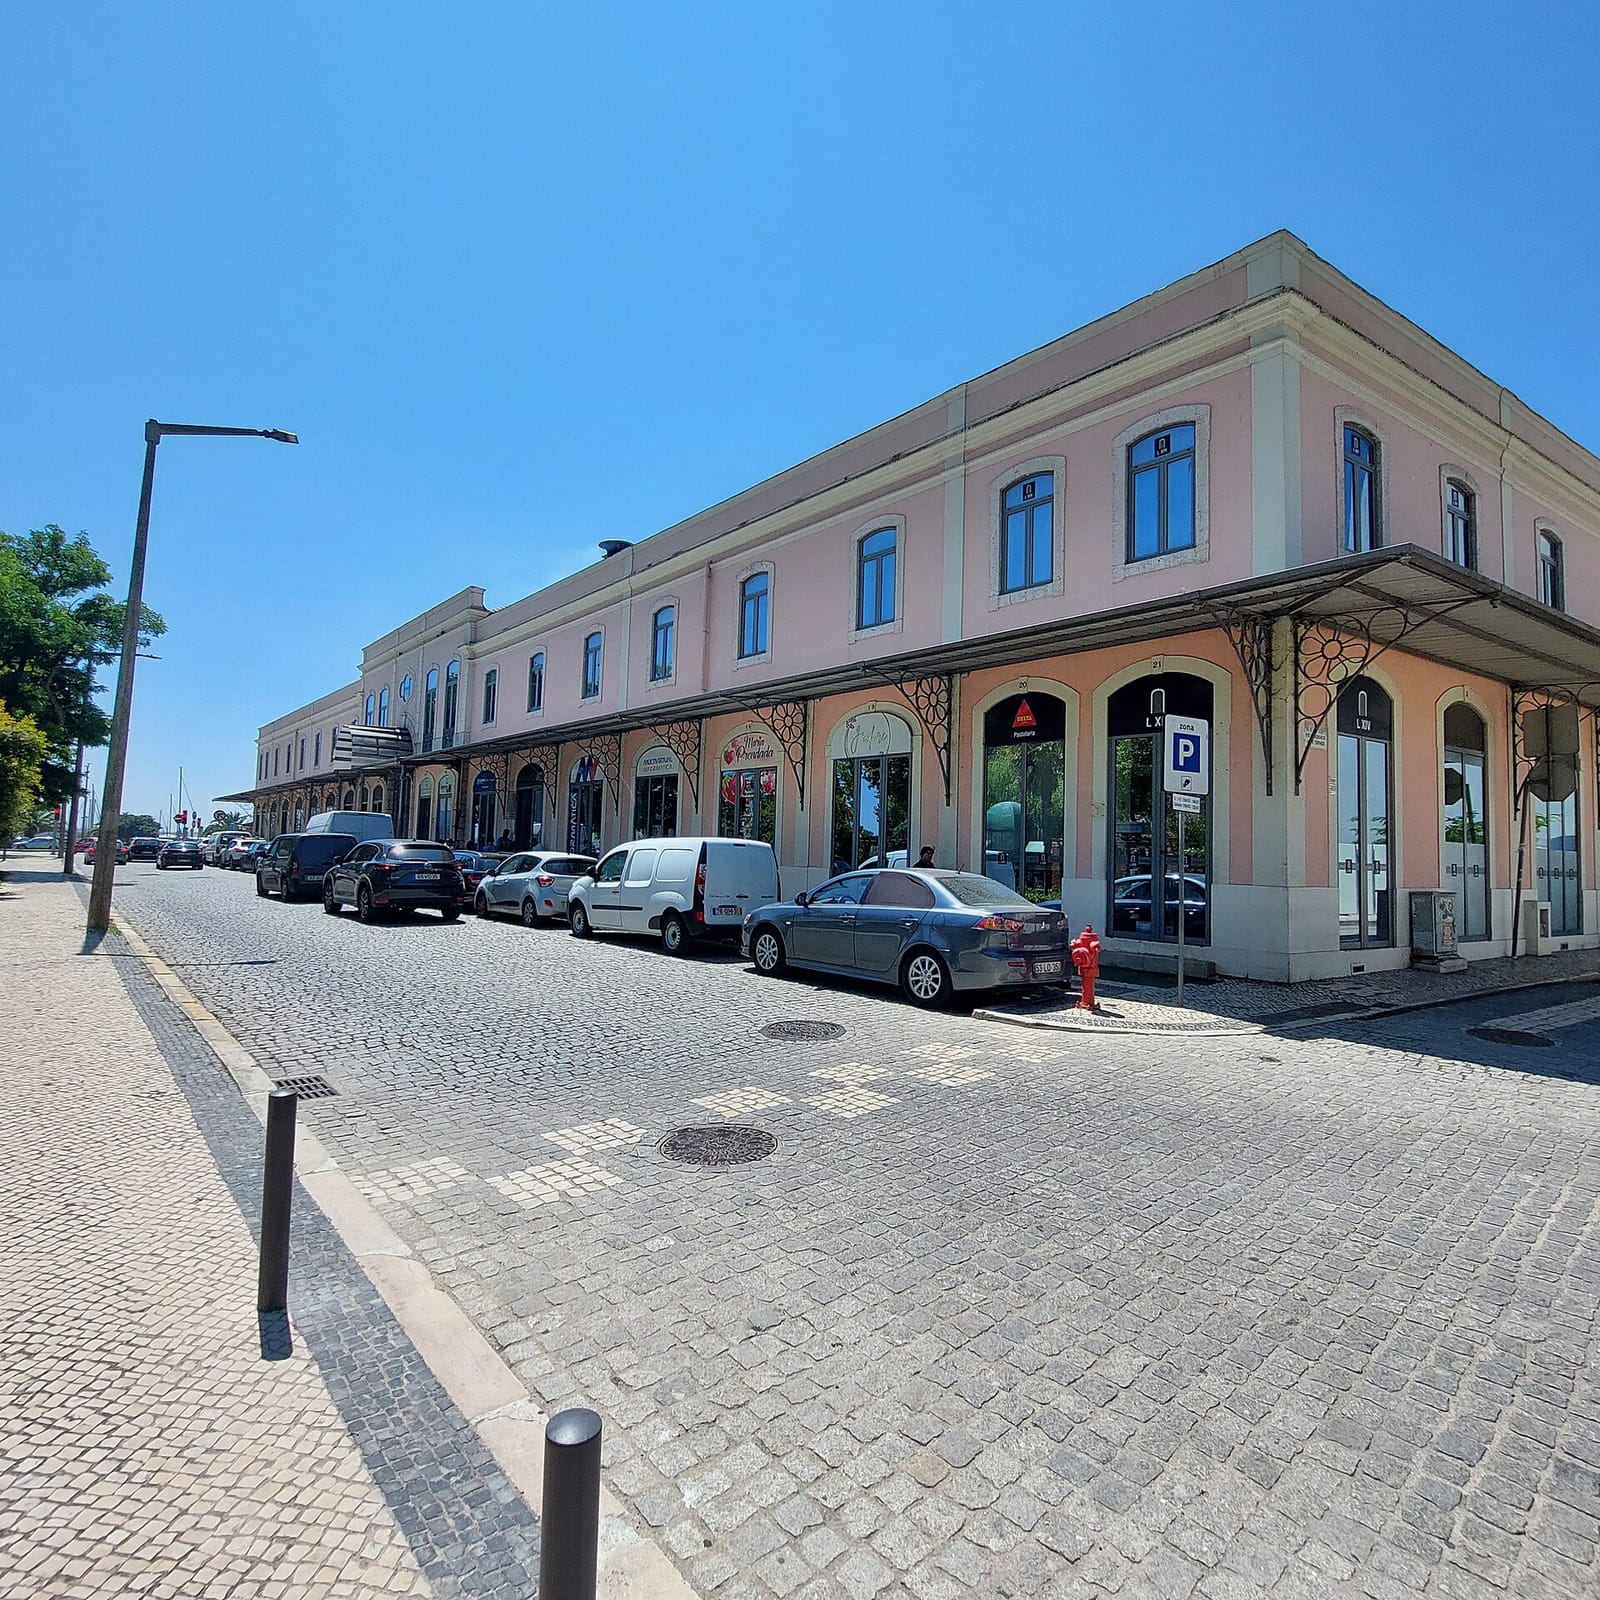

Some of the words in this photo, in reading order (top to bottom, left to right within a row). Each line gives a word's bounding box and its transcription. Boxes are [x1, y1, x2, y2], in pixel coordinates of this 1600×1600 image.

[1152, 661, 1162, 669] 21
[1018, 681, 1028, 689] 20
[1179, 723, 1195, 731] zona
[1178, 738, 1195, 767] P
